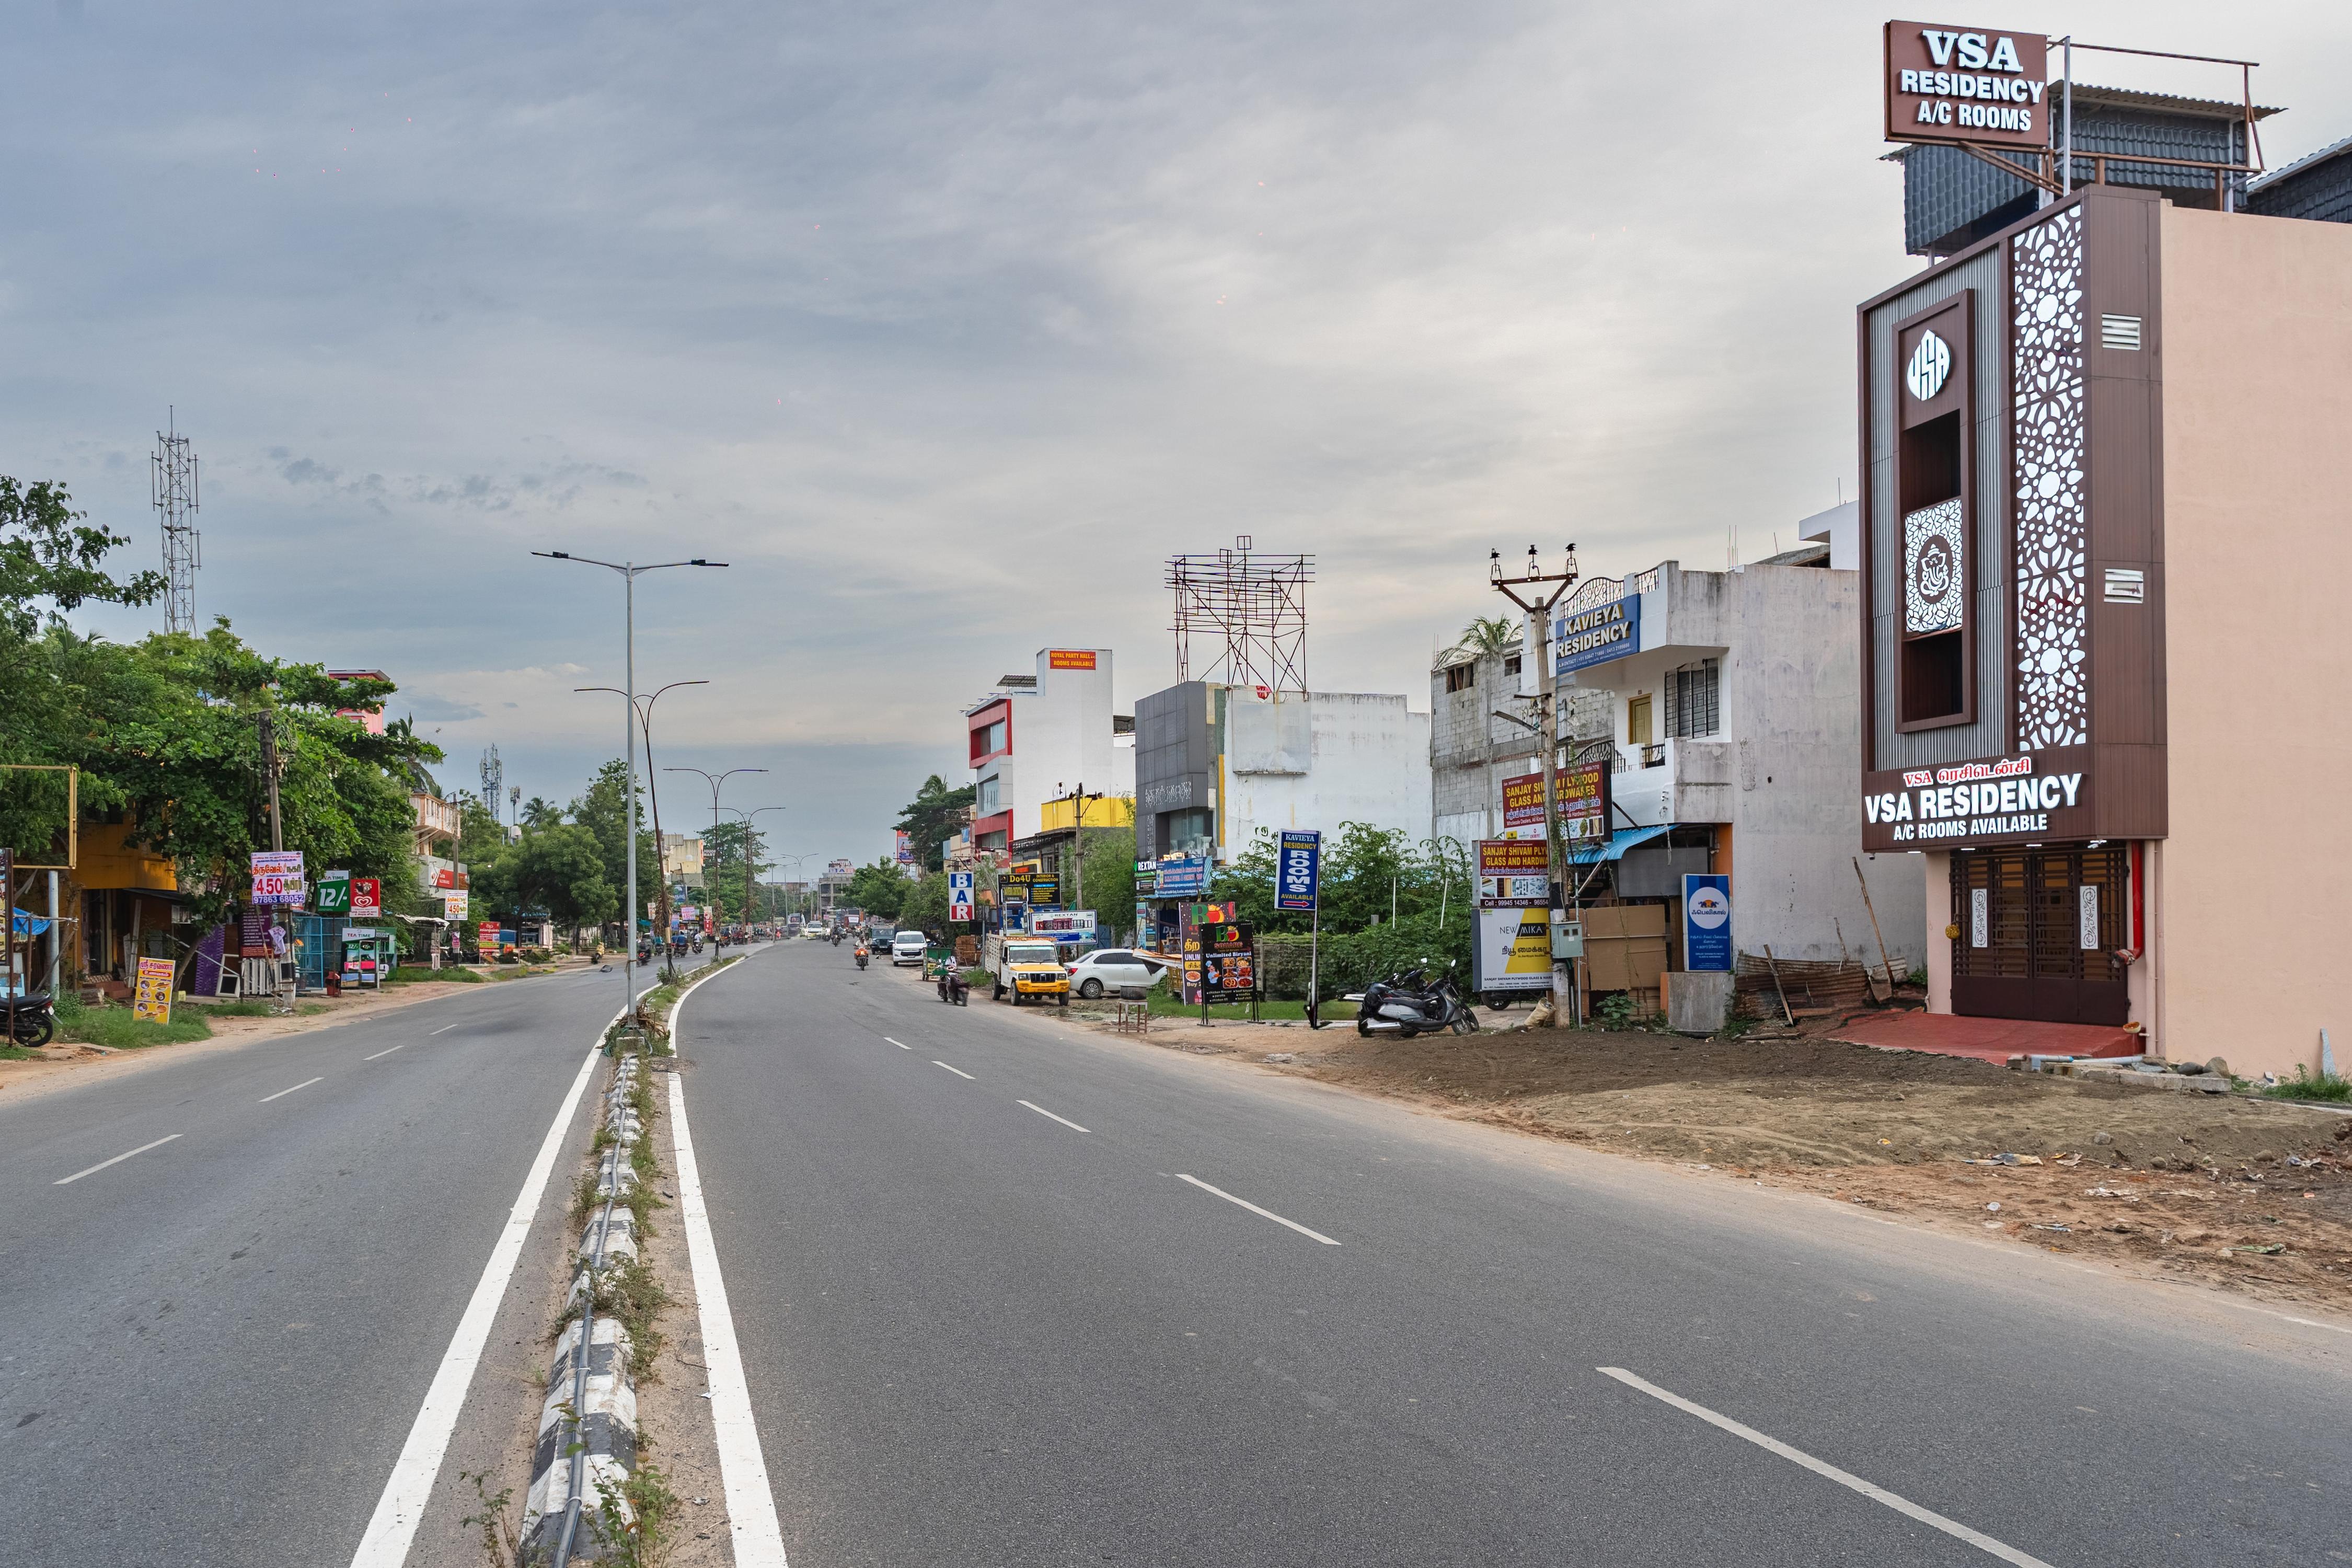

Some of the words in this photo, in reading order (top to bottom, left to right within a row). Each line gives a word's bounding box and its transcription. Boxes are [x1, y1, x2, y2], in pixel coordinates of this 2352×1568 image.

[1922, 29, 2023, 72] VSA
[1901, 69, 2044, 103] RESIDENCY
[1918, 100, 1952, 124] A/C
[1959, 103, 2032, 131] ROOMS
[1564, 604, 1623, 636] KAVIEYA
[1557, 621, 1630, 658] RESIDENCY
[1904, 769, 1934, 788] VSA
[1937, 756, 2033, 785] ரெசிடென்சி
[1506, 783, 1532, 797] SANJAY
[1509, 795, 1531, 808] GLASS
[1865, 792, 1913, 824] VSA
[1920, 773, 2082, 820] RESIDENCY
[1894, 824, 1915, 840] A/C
[1919, 820, 1967, 838] ROOMS
[1970, 814, 2048, 835] AVAILABLE
[1483, 847, 1507, 856] SANJAY
[1508, 847, 1532, 856] SHIVAM
[1486, 857, 1506, 866] GLASS
[1508, 857, 1520, 866] AND
[1138, 861, 1157, 871] REXTAN
[1287, 850, 1310, 893] ROOMS
[253, 895, 278, 904] 97863
[319, 886, 348, 907] 12/-
[955, 874, 969, 919] BAR
[1500, 923, 1518, 934] NEW
[1519, 926, 1542, 937] MIKA
[1502, 946, 1516, 956] நியூ
